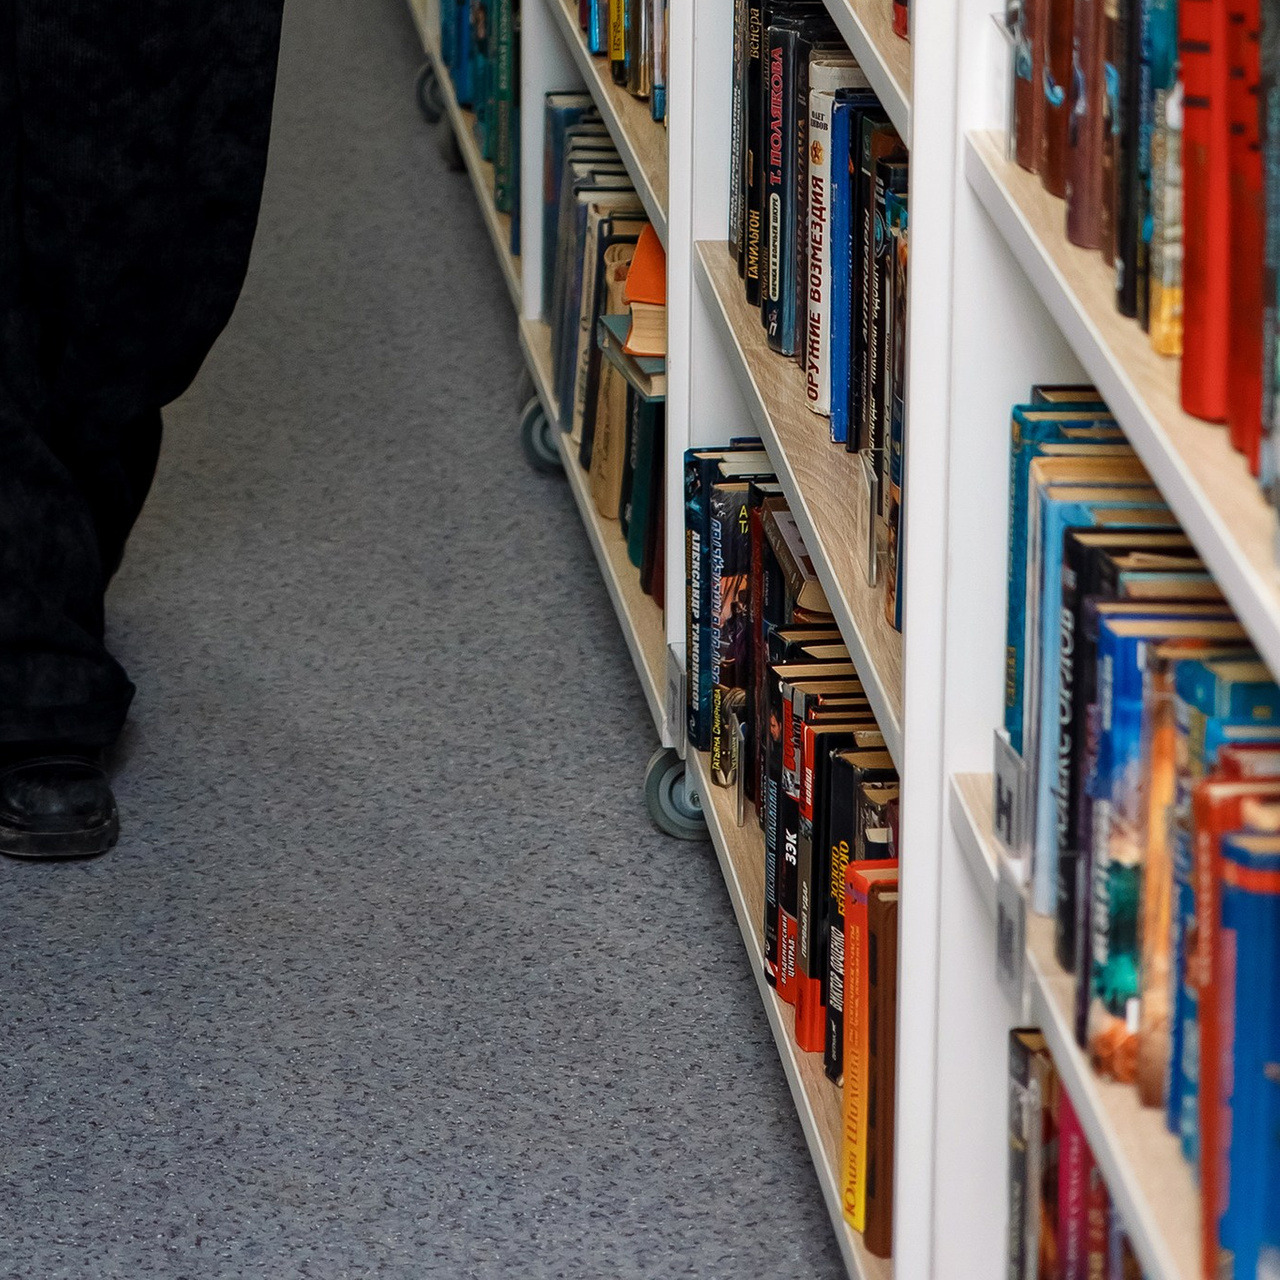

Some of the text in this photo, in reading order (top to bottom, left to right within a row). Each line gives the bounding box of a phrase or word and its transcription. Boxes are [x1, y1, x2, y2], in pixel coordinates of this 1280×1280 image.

[770, 47, 784, 186] Т. ПОЛЯКОВА
[748, 209, 760, 280] ГАМИЛЬТОН
[807, 174, 826, 402] ОРУЖИЕ ВОЗМЕЗДИЯ
[692, 530, 702, 619] АЛЕКСАНДР
[712, 687, 722, 774] ТАТЬЯНА СМИРНОВА
[785, 828, 798, 866] ЗЭК
[830, 845, 840, 903] ЗОЛОТО
[837, 840, 850, 918] БЕШЕНОГО
[800, 880, 809, 958] ПЕРВЫЙ УДАР
[830, 925, 845, 976] ДОЦЕНКО
[829, 970, 843, 1013] ВИКТОР
